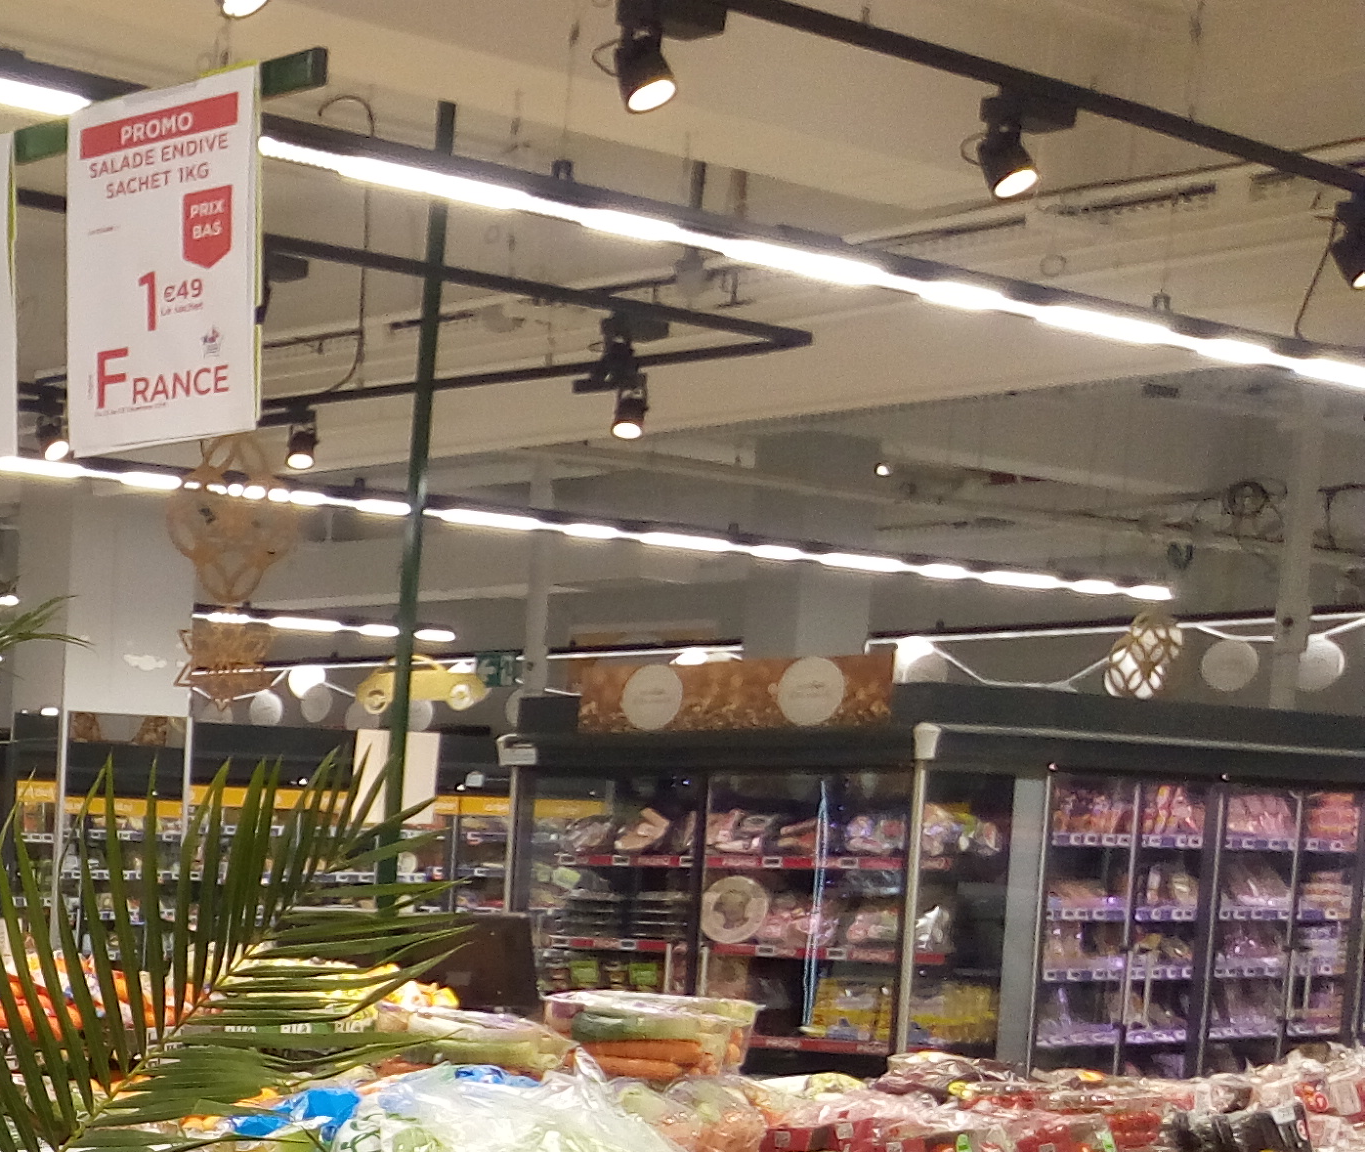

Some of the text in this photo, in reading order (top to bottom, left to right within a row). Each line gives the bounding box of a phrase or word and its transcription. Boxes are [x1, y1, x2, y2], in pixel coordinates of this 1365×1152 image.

[120, 112, 194, 146] PROMO
[89, 133, 229, 179] SALADE ENDIVE
[106, 162, 210, 199] SACHET 1KG
[190, 199, 224, 219] PRIX
[192, 220, 222, 239] BAS
